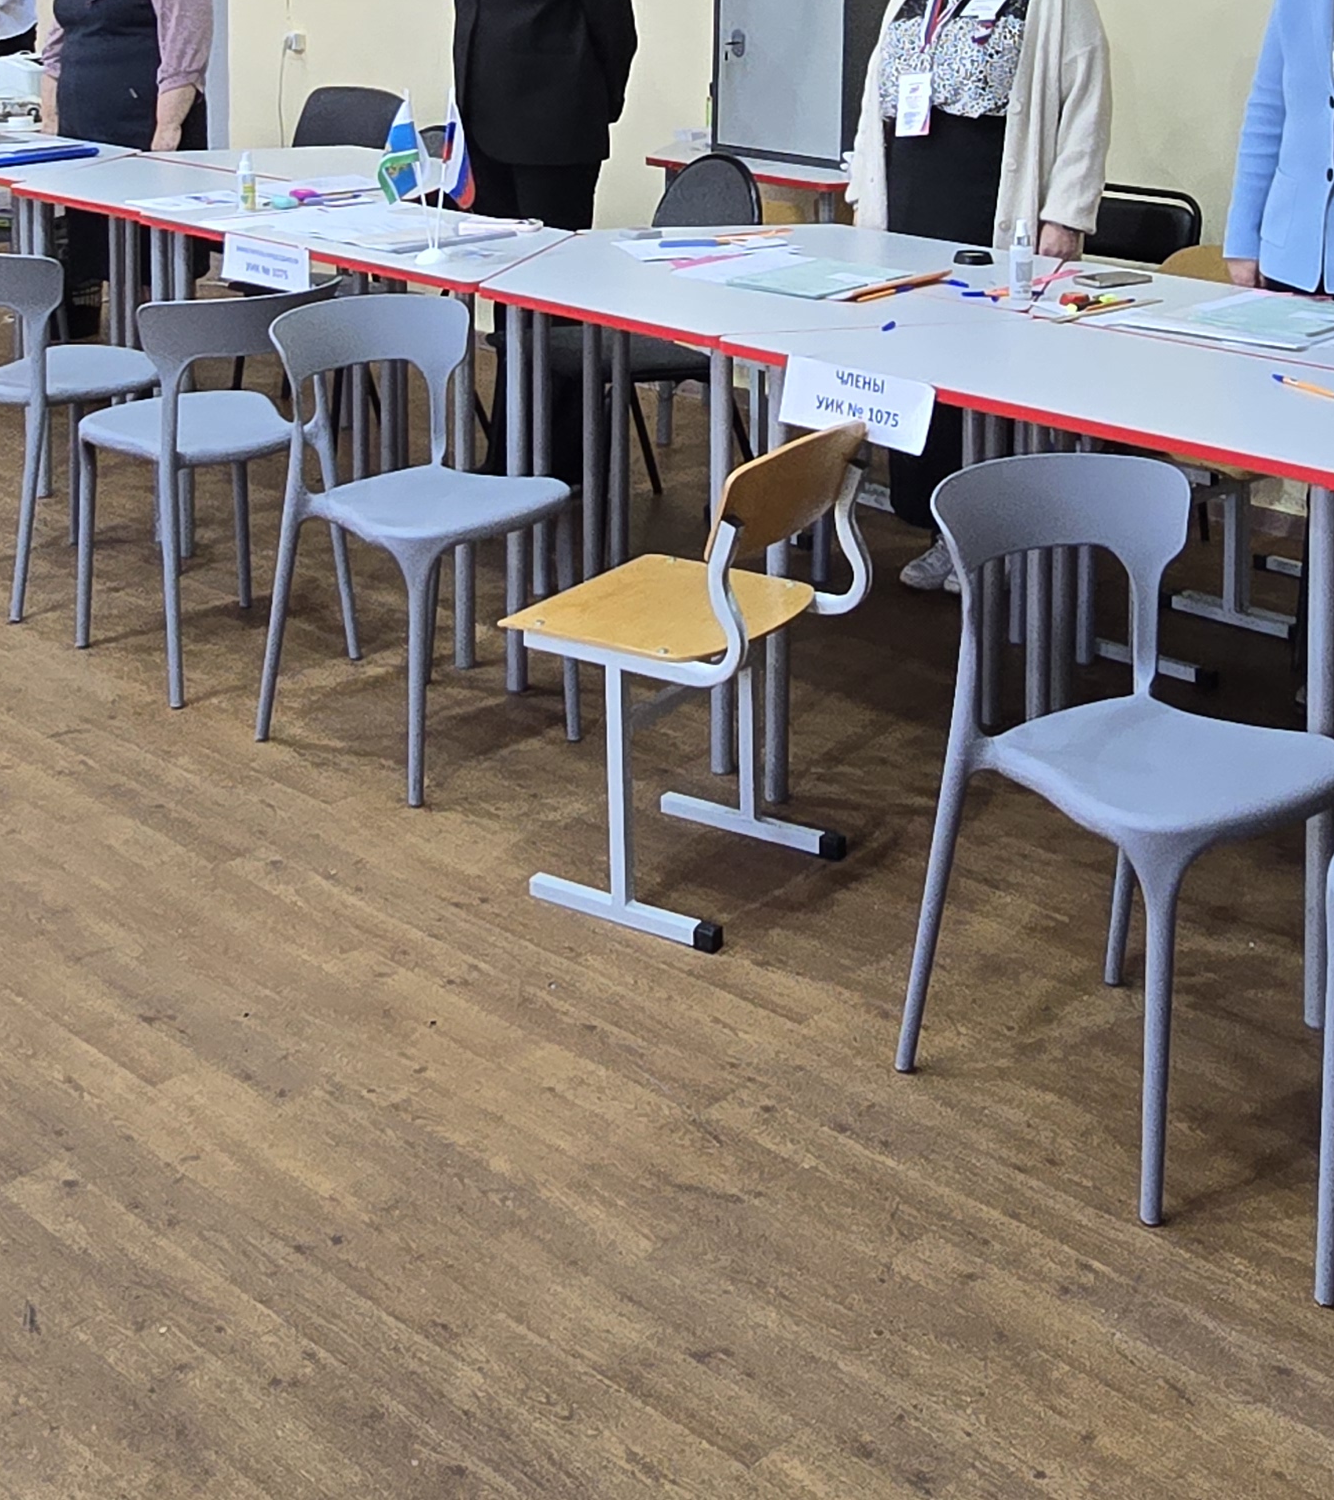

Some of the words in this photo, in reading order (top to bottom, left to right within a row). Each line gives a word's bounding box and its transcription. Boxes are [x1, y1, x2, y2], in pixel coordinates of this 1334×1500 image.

[835, 369, 885, 394] ЧЛЕНЫ
[816, 394, 844, 415] УИК
[847, 402, 864, 419] №
[868, 407, 900, 428] 1075
